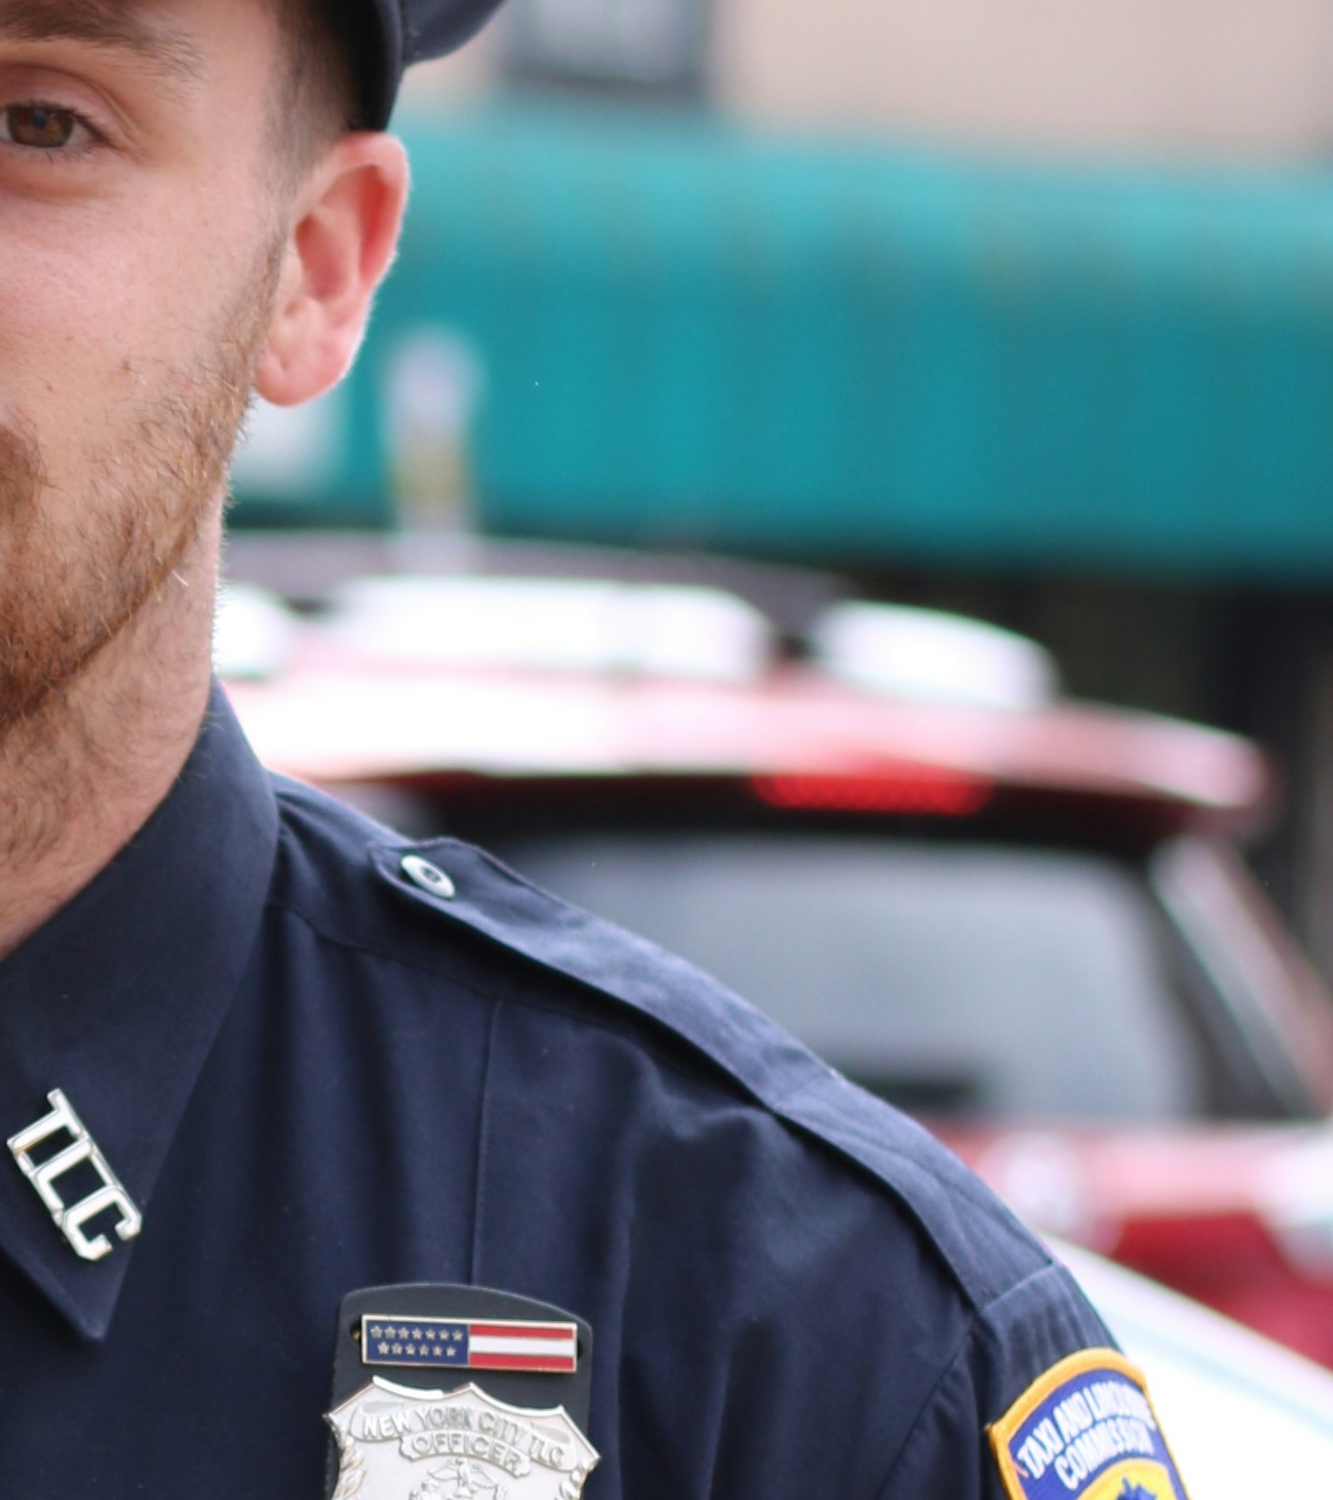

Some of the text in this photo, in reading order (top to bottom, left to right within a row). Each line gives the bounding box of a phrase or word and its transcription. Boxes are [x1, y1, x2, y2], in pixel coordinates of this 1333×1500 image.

[6, 1088, 142, 1261] TLC
[363, 1404, 566, 1468] NEW YORK CITY TLC
[411, 1433, 524, 1474] OFFICER
[1017, 1417, 1064, 1479] TAXI
[1053, 1391, 1093, 1444] AND
